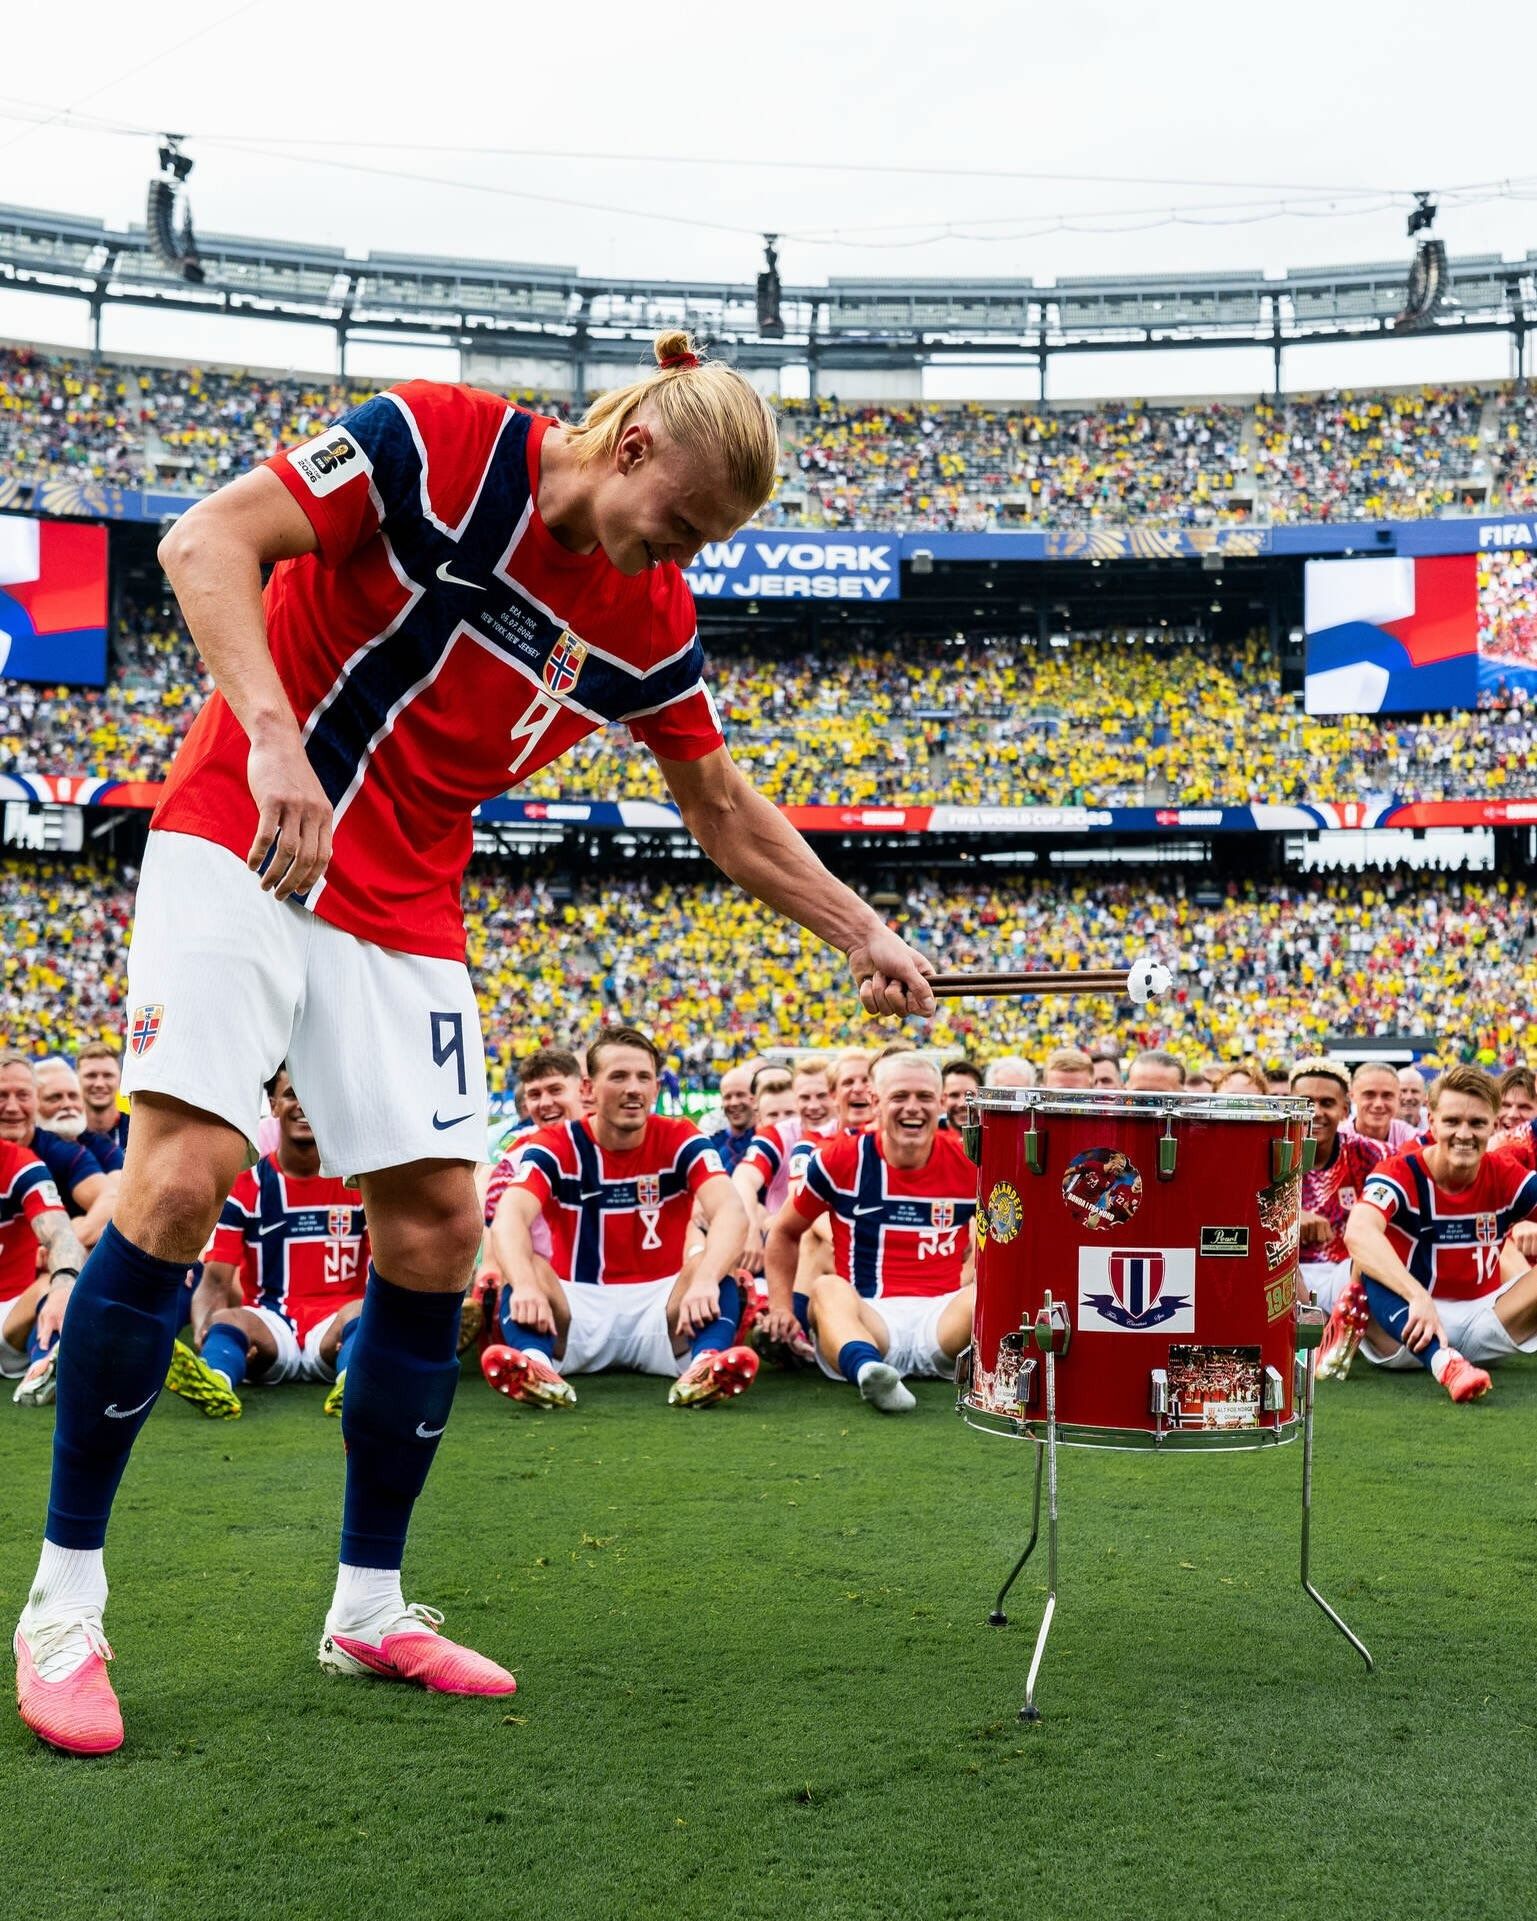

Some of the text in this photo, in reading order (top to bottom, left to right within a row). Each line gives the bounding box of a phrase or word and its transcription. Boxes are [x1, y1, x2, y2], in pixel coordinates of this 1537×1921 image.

[298, 460, 318, 483] 2026
[1479, 523, 1533, 547] FIFA
[755, 543, 891, 571] YORK
[732, 574, 891, 598] JERSEY
[480, 612, 541, 660] NEW YORK NEW JERSEY
[508, 689, 562, 775] 9
[430, 1012, 467, 1095] 9
[639, 1210, 662, 1250] 8
[1210, 1230, 1239, 1244] Pearl
[324, 1241, 360, 1283] 22
[1472, 1246, 1500, 1285] 10
